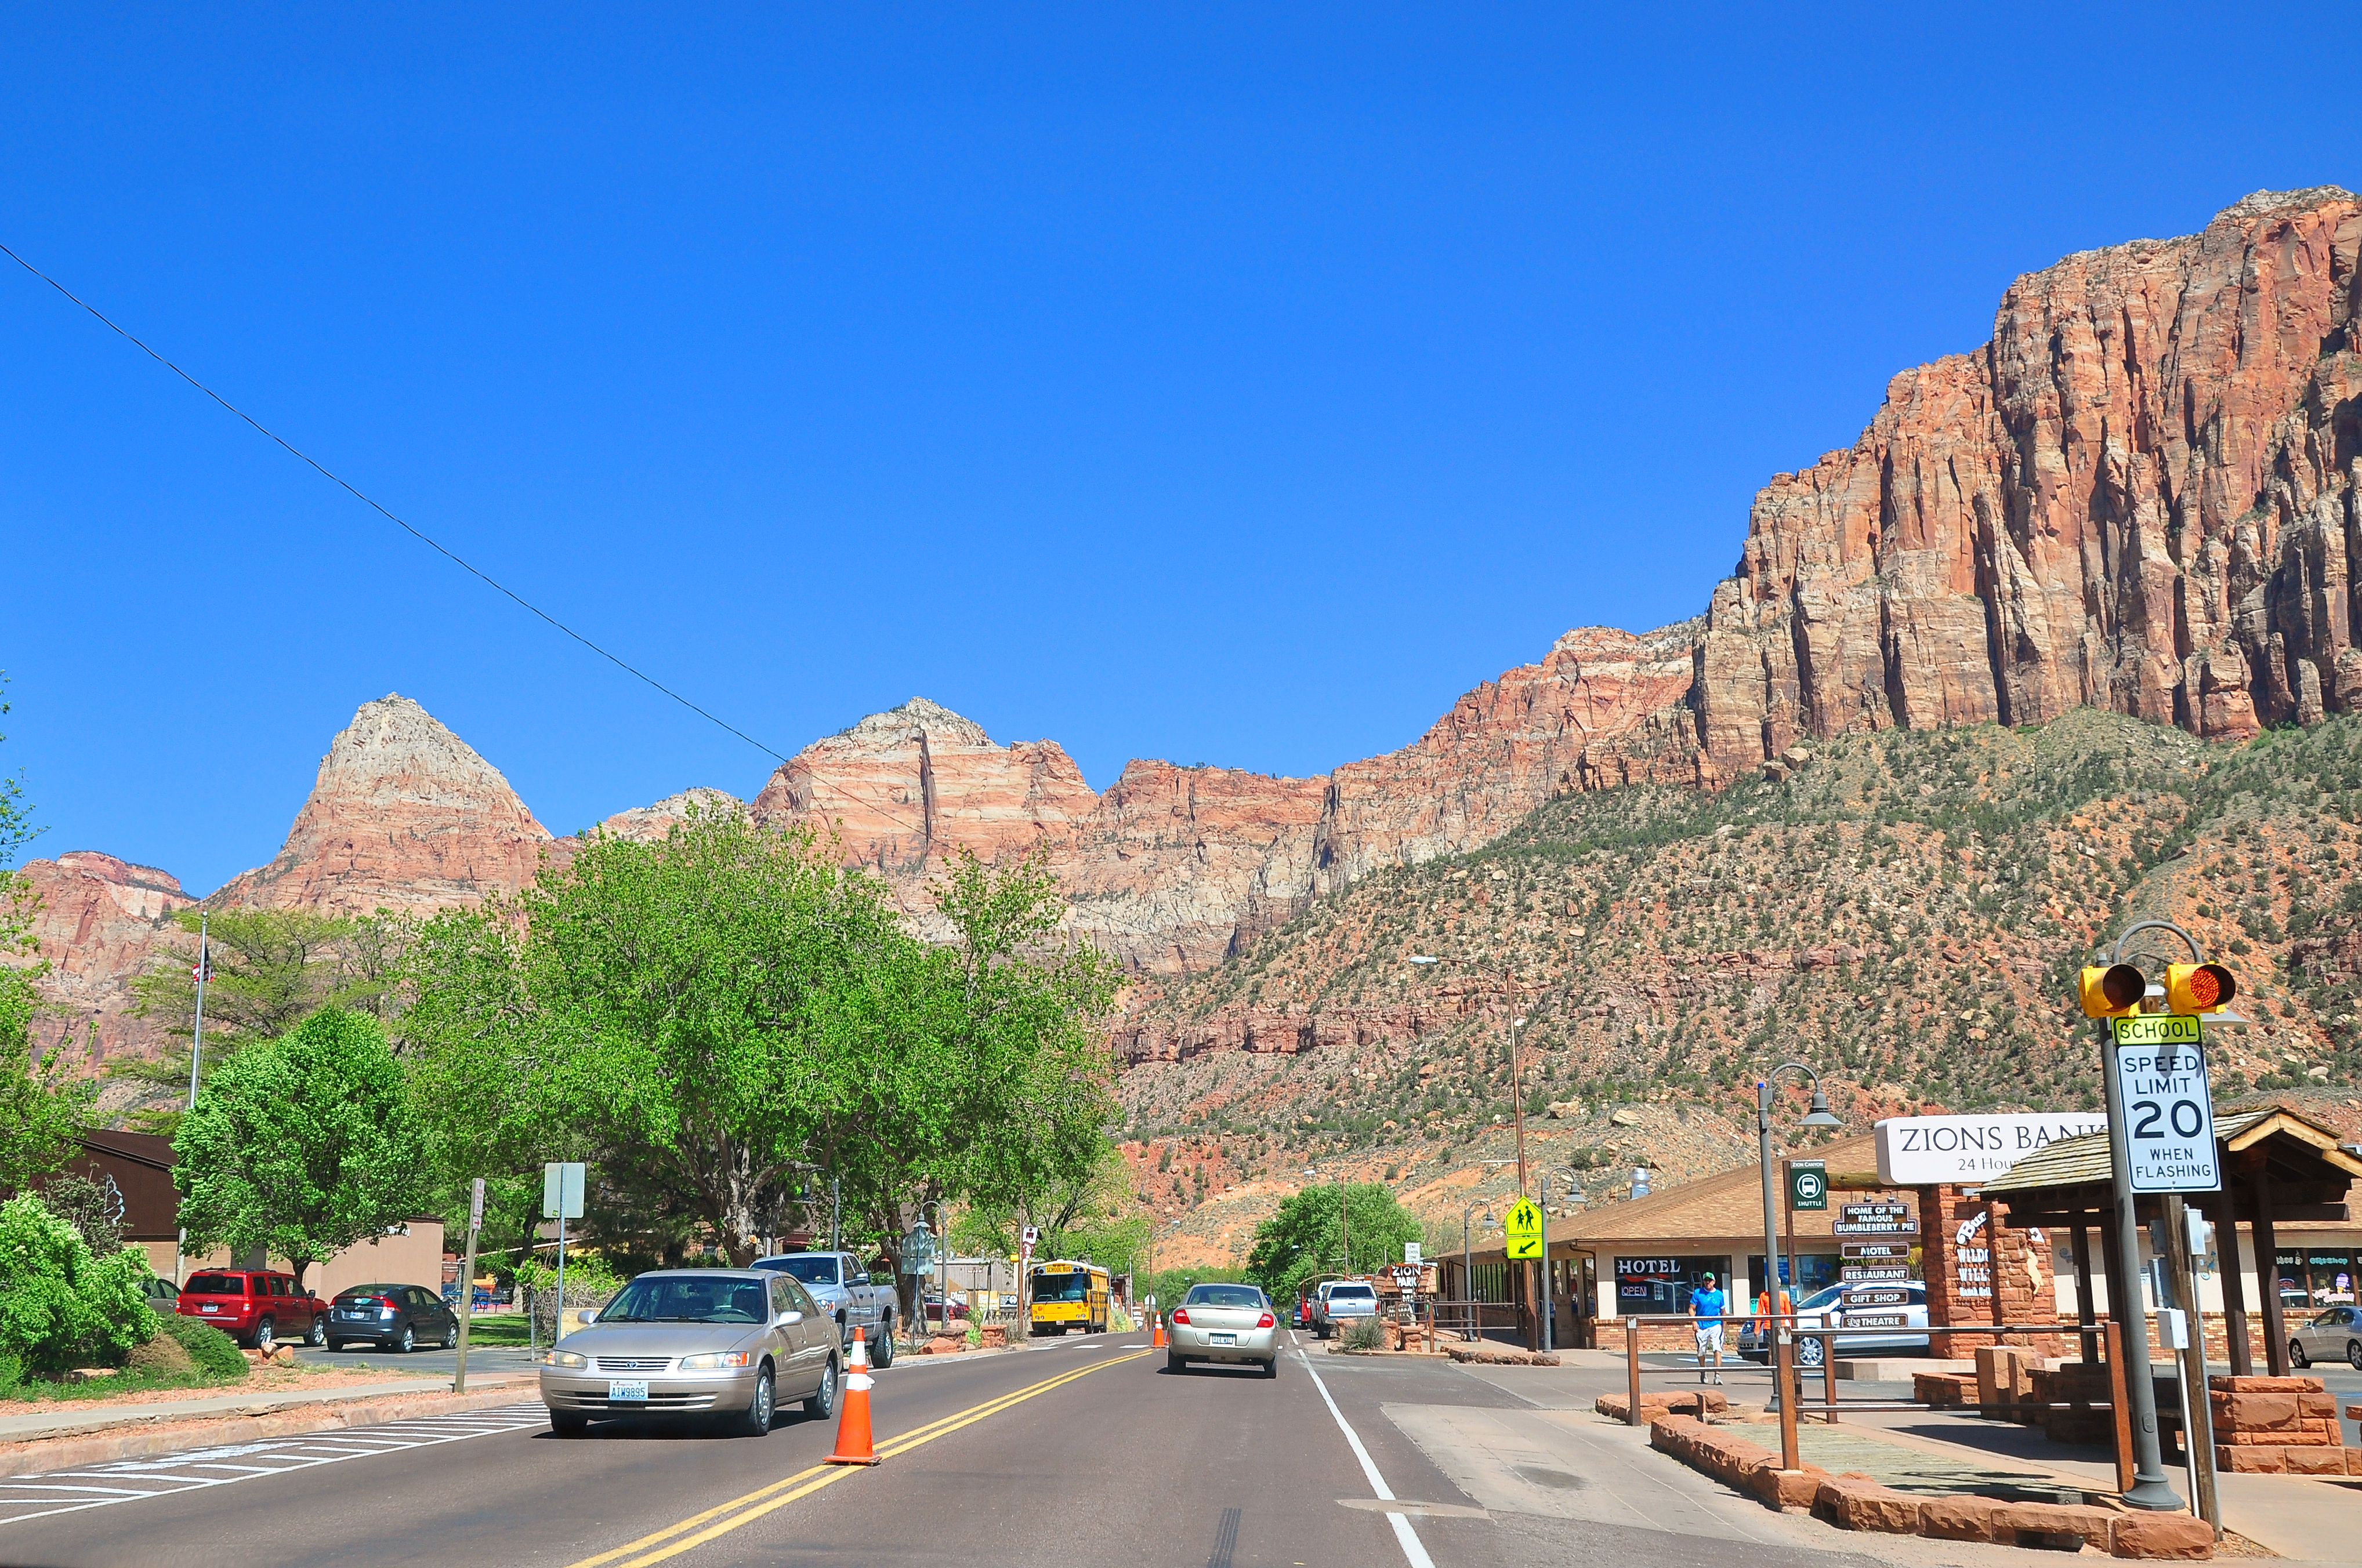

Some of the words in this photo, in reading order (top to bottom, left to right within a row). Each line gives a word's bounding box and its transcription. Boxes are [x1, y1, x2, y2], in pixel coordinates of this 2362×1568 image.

[2120, 1021, 2196, 1039] SCHOOL
[2124, 1055, 2198, 1072] SPEED
[2135, 1077, 2190, 1095] LIMIT
[2131, 1099, 2203, 1139] 20
[1900, 1126, 2002, 1152] ZIONS
[2150, 1148, 2193, 1160] WHEN
[1958, 1158, 1976, 1171] 24
[2136, 1164, 2211, 1178] FLASHING
[1847, 1207, 1872, 1215] HOME
[1889, 1206, 1904, 1214] THE
[1858, 1214, 1893, 1222] FAMOUS
[1836, 1222, 1899, 1232] BUMBLEBERRY
[1901, 1222, 1915, 1231] PIE
[1860, 1247, 1892, 1256] MOTEL
[1392, 1265, 1421, 1276] ZION
[1617, 1260, 1680, 1273] HOTEL
[1845, 1270, 1906, 1280] RESTAURANT
[1623, 1287, 1646, 1296] OPEN
[1850, 1294, 1871, 1304] GIFT
[1874, 1294, 1900, 1302] SHOP
[1861, 1317, 1900, 1326] THEATRE
[611, 1387, 646, 1397] AIW9895
